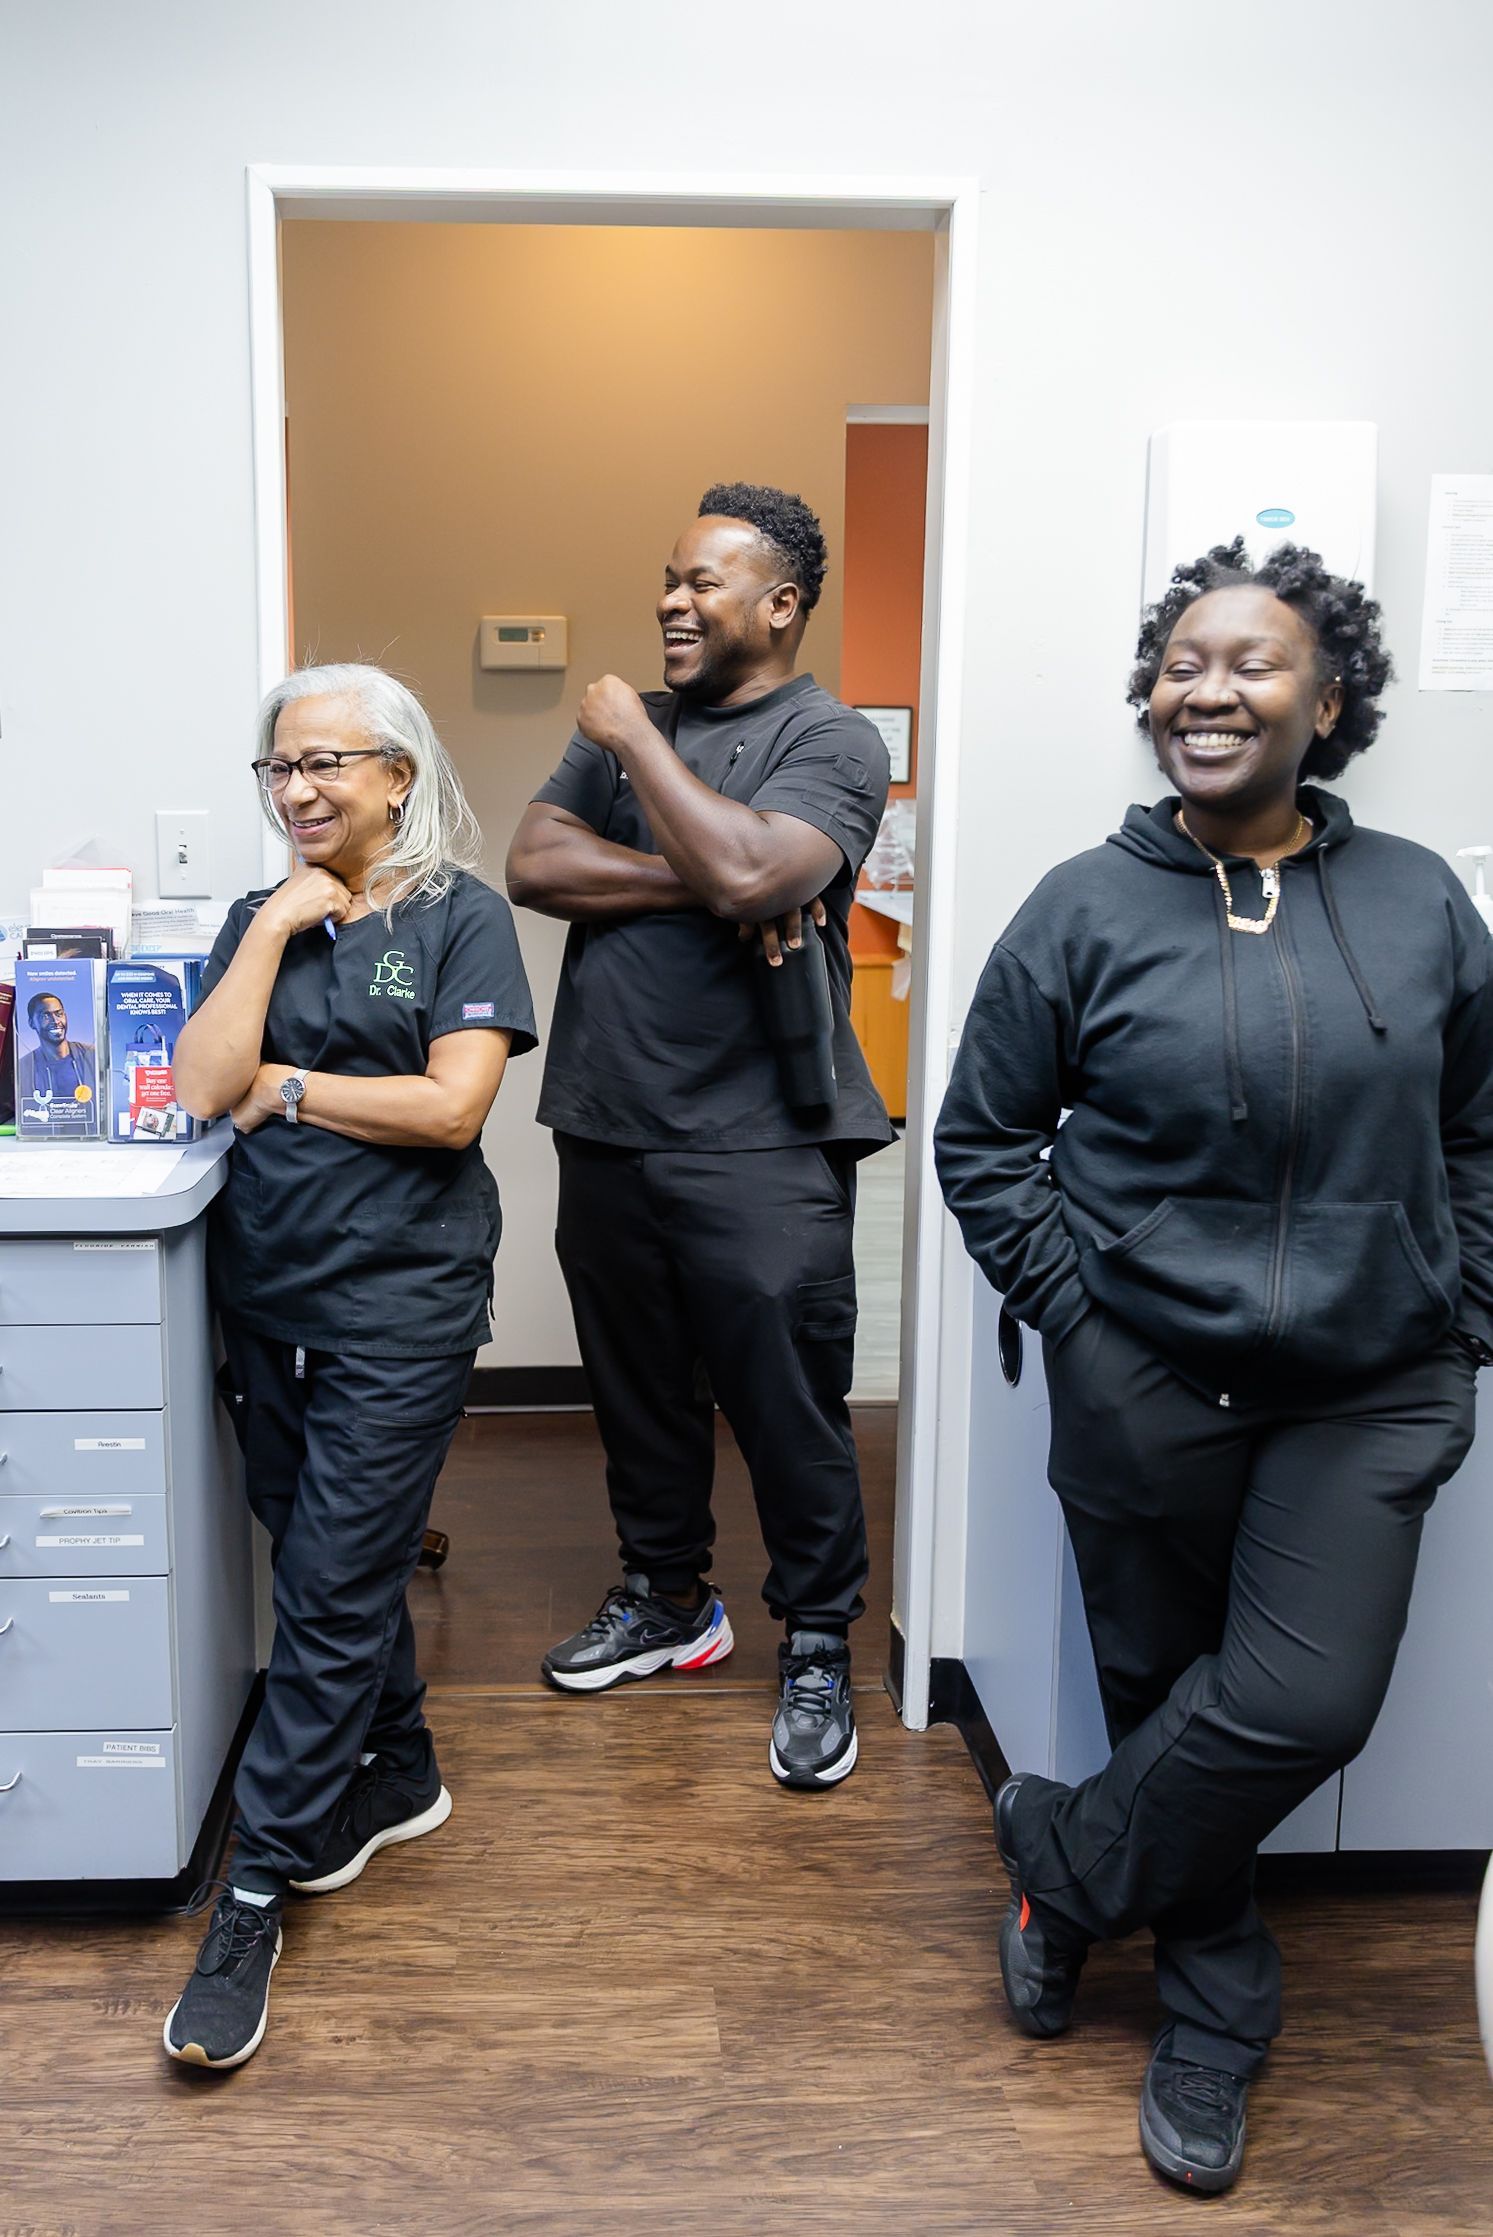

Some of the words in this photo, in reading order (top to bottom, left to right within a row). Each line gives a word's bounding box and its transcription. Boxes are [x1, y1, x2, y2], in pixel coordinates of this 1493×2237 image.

[369, 984, 382, 996] Dr.
[386, 985, 416, 999] Clarke
[58, 1537, 91, 1545] PROPHY
[71, 1592, 106, 1601] Sealants
[105, 1743, 138, 1752] PATIENT
[138, 1745, 157, 1753] BIBS
